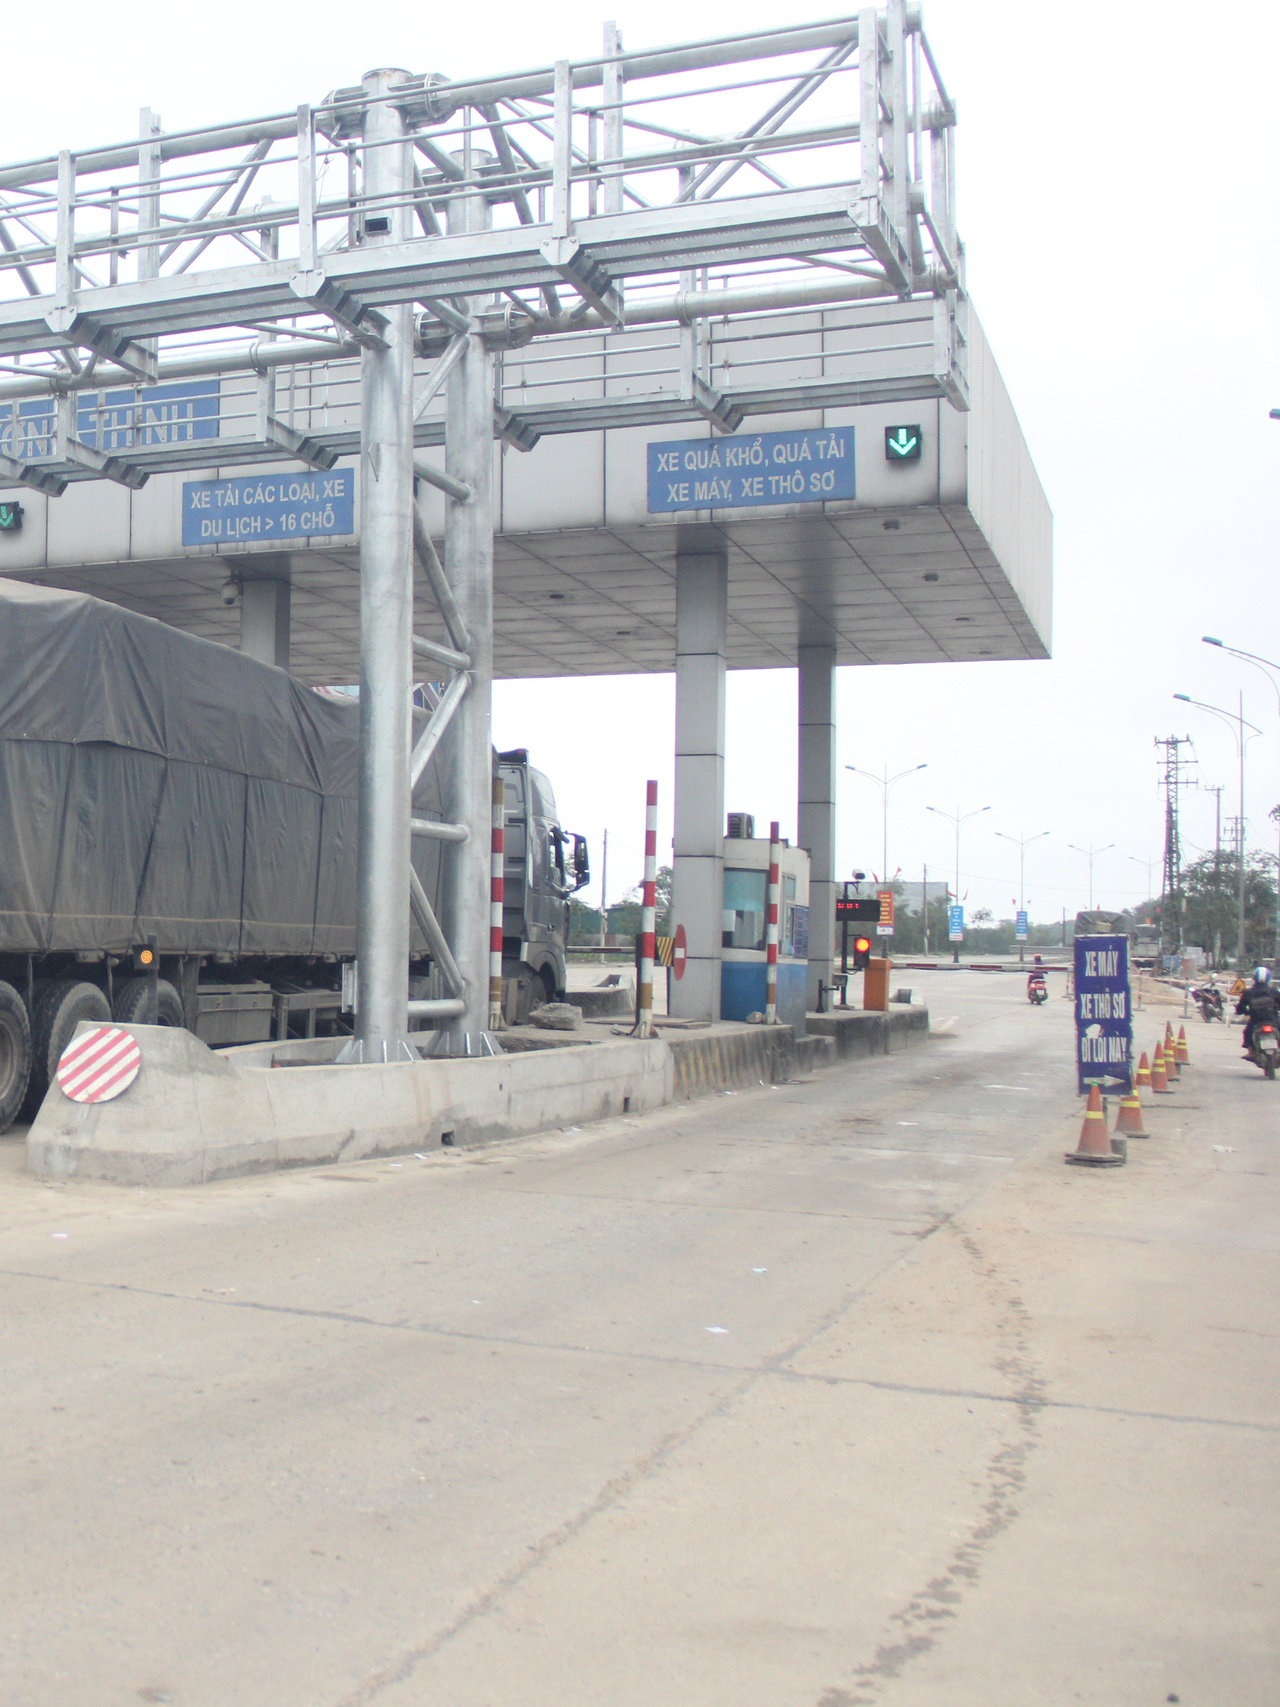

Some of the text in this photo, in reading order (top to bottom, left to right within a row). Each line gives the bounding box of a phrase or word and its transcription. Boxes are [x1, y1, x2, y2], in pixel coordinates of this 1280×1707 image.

[657, 433, 845, 472] XE QUÁ KHỔ, QUÁ TẢI
[191, 479, 345, 509] XE TẢI CÁC LOẠI, XE
[667, 470, 835, 502] XE MÁY, XE THÔ SƠ
[201, 519, 222, 537] DU
[227, 516, 261, 538] LỊCH
[280, 513, 296, 531] 16
[301, 503, 335, 530] CHỖ
[1085, 945, 1118, 976] XE MÁY
[1080, 988, 1126, 1019] XE THÔ SƠ
[1109, 1031, 1126, 1062] NÀY
